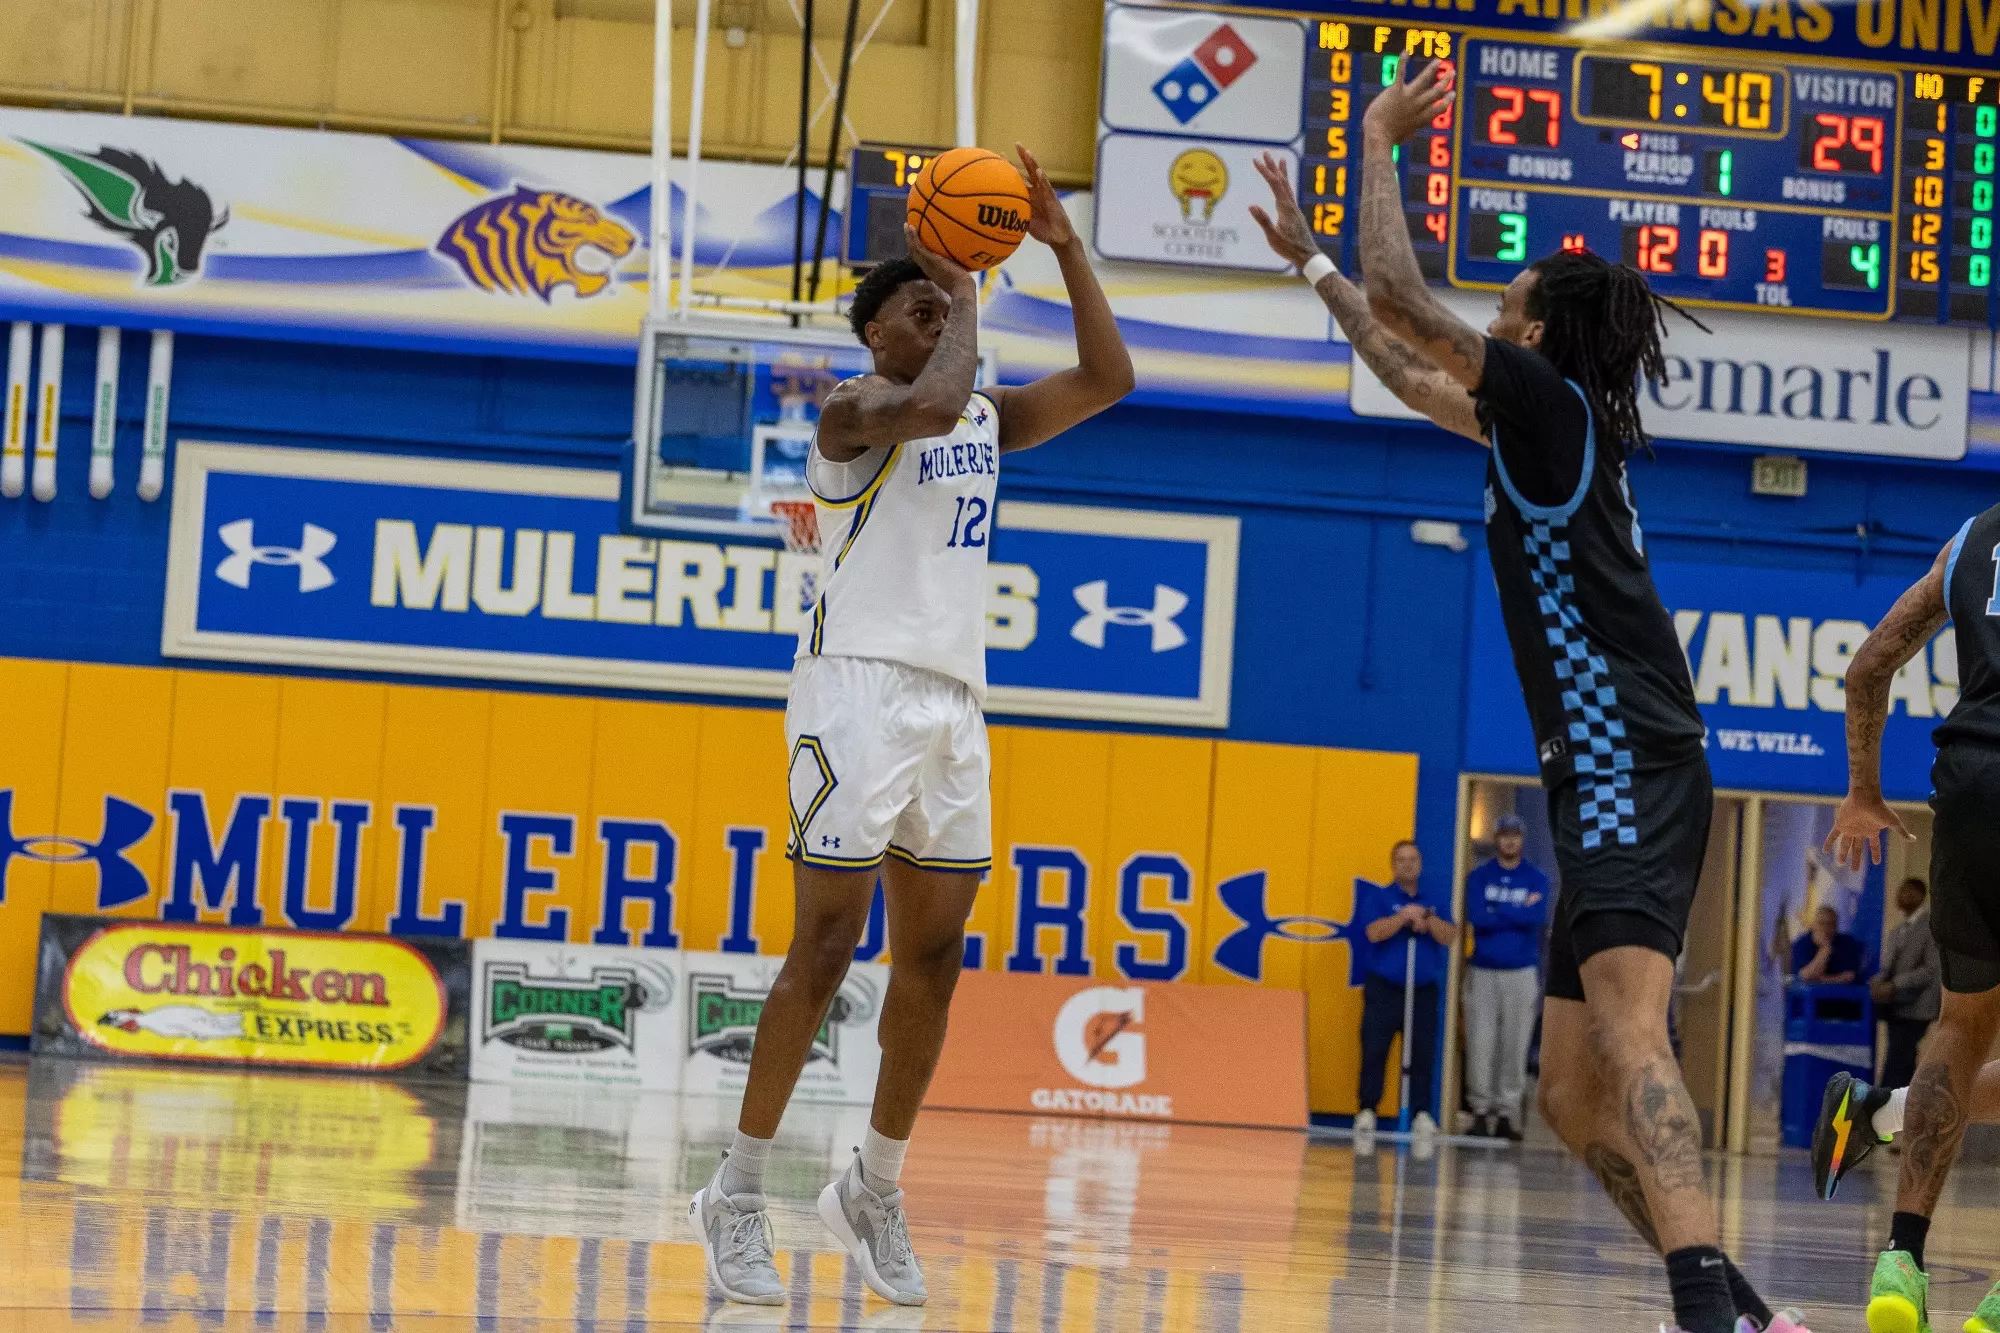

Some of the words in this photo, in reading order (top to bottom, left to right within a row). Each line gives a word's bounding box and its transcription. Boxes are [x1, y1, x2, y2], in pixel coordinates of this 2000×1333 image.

[1497, 0, 1834, 43] NSAS
[1374, 26, 1391, 53] F
[1406, 29, 1451, 58] PTS
[1331, 52, 1350, 84] 0
[1480, 47, 1559, 80] HOME
[1330, 88, 1350, 121] 3
[1630, 62, 1772, 130] 7:40
[1795, 73, 1895, 109] VISITOR
[1968, 77, 1985, 103] F
[1488, 86, 1561, 148] 27
[1937, 103, 1947, 133] 1
[1976, 105, 1997, 137] 0
[1328, 127, 1346, 160] 5
[1430, 135, 1450, 168] 6
[1813, 113, 1884, 174] 29
[1925, 139, 1945, 171] 3
[1974, 143, 1994, 175] 0
[1508, 155, 1573, 181] BONUS
[1624, 150, 1694, 176] PERIOD
[1719, 150, 1732, 195] 1
[1315, 165, 1347, 197] 11
[1427, 173, 1450, 206] 0
[1469, 188, 1527, 212] FOULS
[1782, 177, 1847, 203] BONUS
[1914, 176, 1944, 208] 10
[1973, 180, 1993, 211] 0
[1313, 202, 1344, 235] 12
[1425, 212, 1447, 243] 4
[1609, 199, 1680, 225] PLAYER
[1700, 207, 1756, 232] FOULS
[1823, 217, 1879, 241] FOULS
[1912, 213, 1942, 245] 12
[1971, 217, 1992, 249] 0
[1497, 213, 1527, 261] 3
[1638, 225, 1679, 273] 12
[1698, 229, 1728, 279] 0
[1766, 249, 1786, 282] 3
[1851, 243, 1880, 289] 4
[1910, 251, 1940, 283] 15
[1969, 254, 1990, 287] 0
[1755, 283, 1792, 307] TOL
[1636, 348, 1943, 430] emarle
[918, 442, 996, 485] MULERIE
[947, 497, 987, 548] 12
[1716, 729, 1754, 752] WE
[160, 787, 1193, 983] MULERIRS
[124, 941, 390, 1009] Chicken
[493, 979, 626, 1034] CORNER
[256, 1015, 393, 1044] EXPRESS
[1053, 986, 1146, 1088] G
[1031, 1088, 1172, 1115] GATORADE
